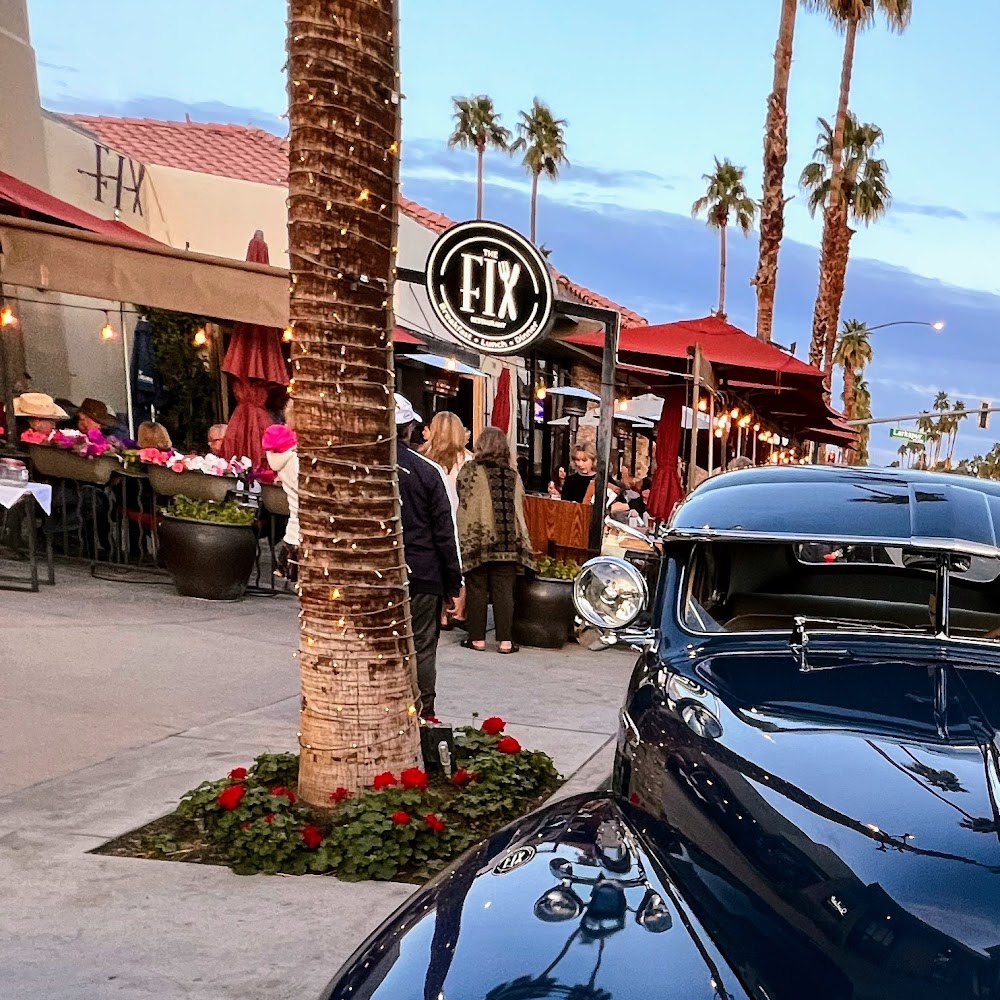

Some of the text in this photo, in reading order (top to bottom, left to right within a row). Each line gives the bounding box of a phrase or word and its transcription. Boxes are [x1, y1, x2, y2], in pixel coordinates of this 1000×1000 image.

[482, 248, 499, 259] THE
[459, 252, 521, 321] FIX
[438, 302, 539, 348] Breakfast Lunch Dinner
